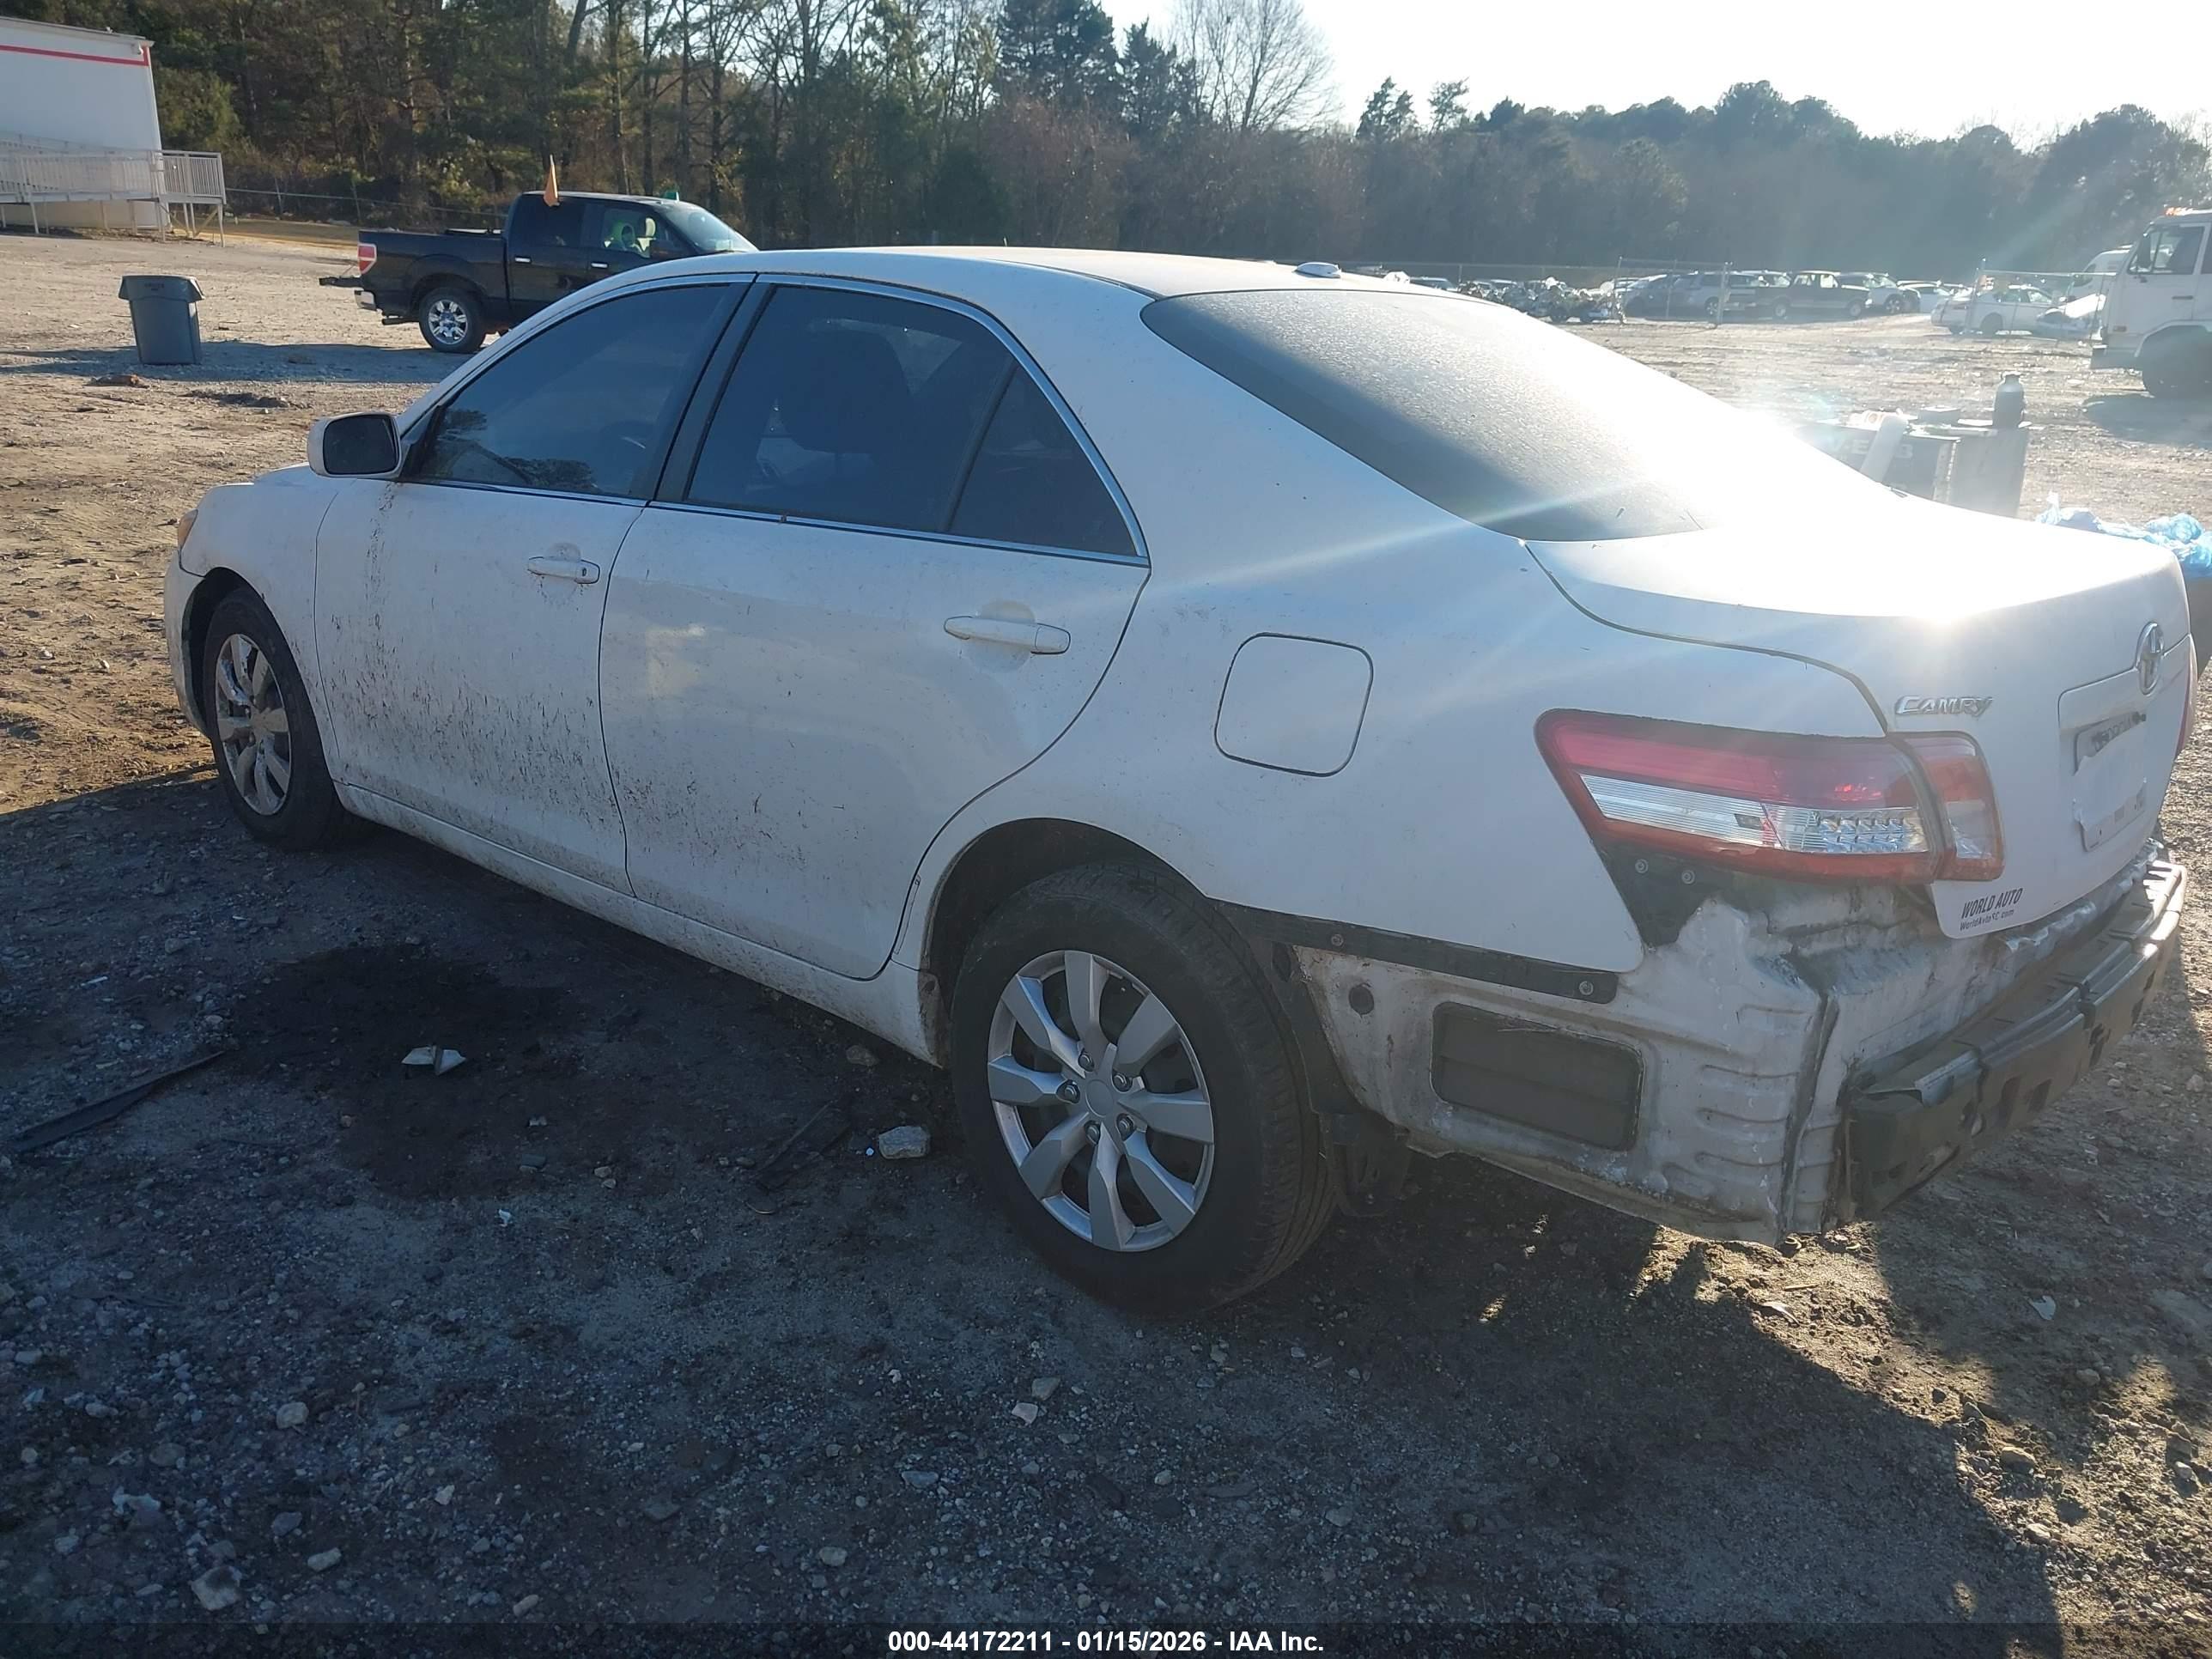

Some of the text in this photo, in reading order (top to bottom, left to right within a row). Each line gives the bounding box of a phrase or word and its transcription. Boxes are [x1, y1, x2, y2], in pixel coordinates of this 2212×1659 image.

[1894, 696, 1993, 717] CAMRY
[1961, 888, 2023, 919] WORLD AUTO
